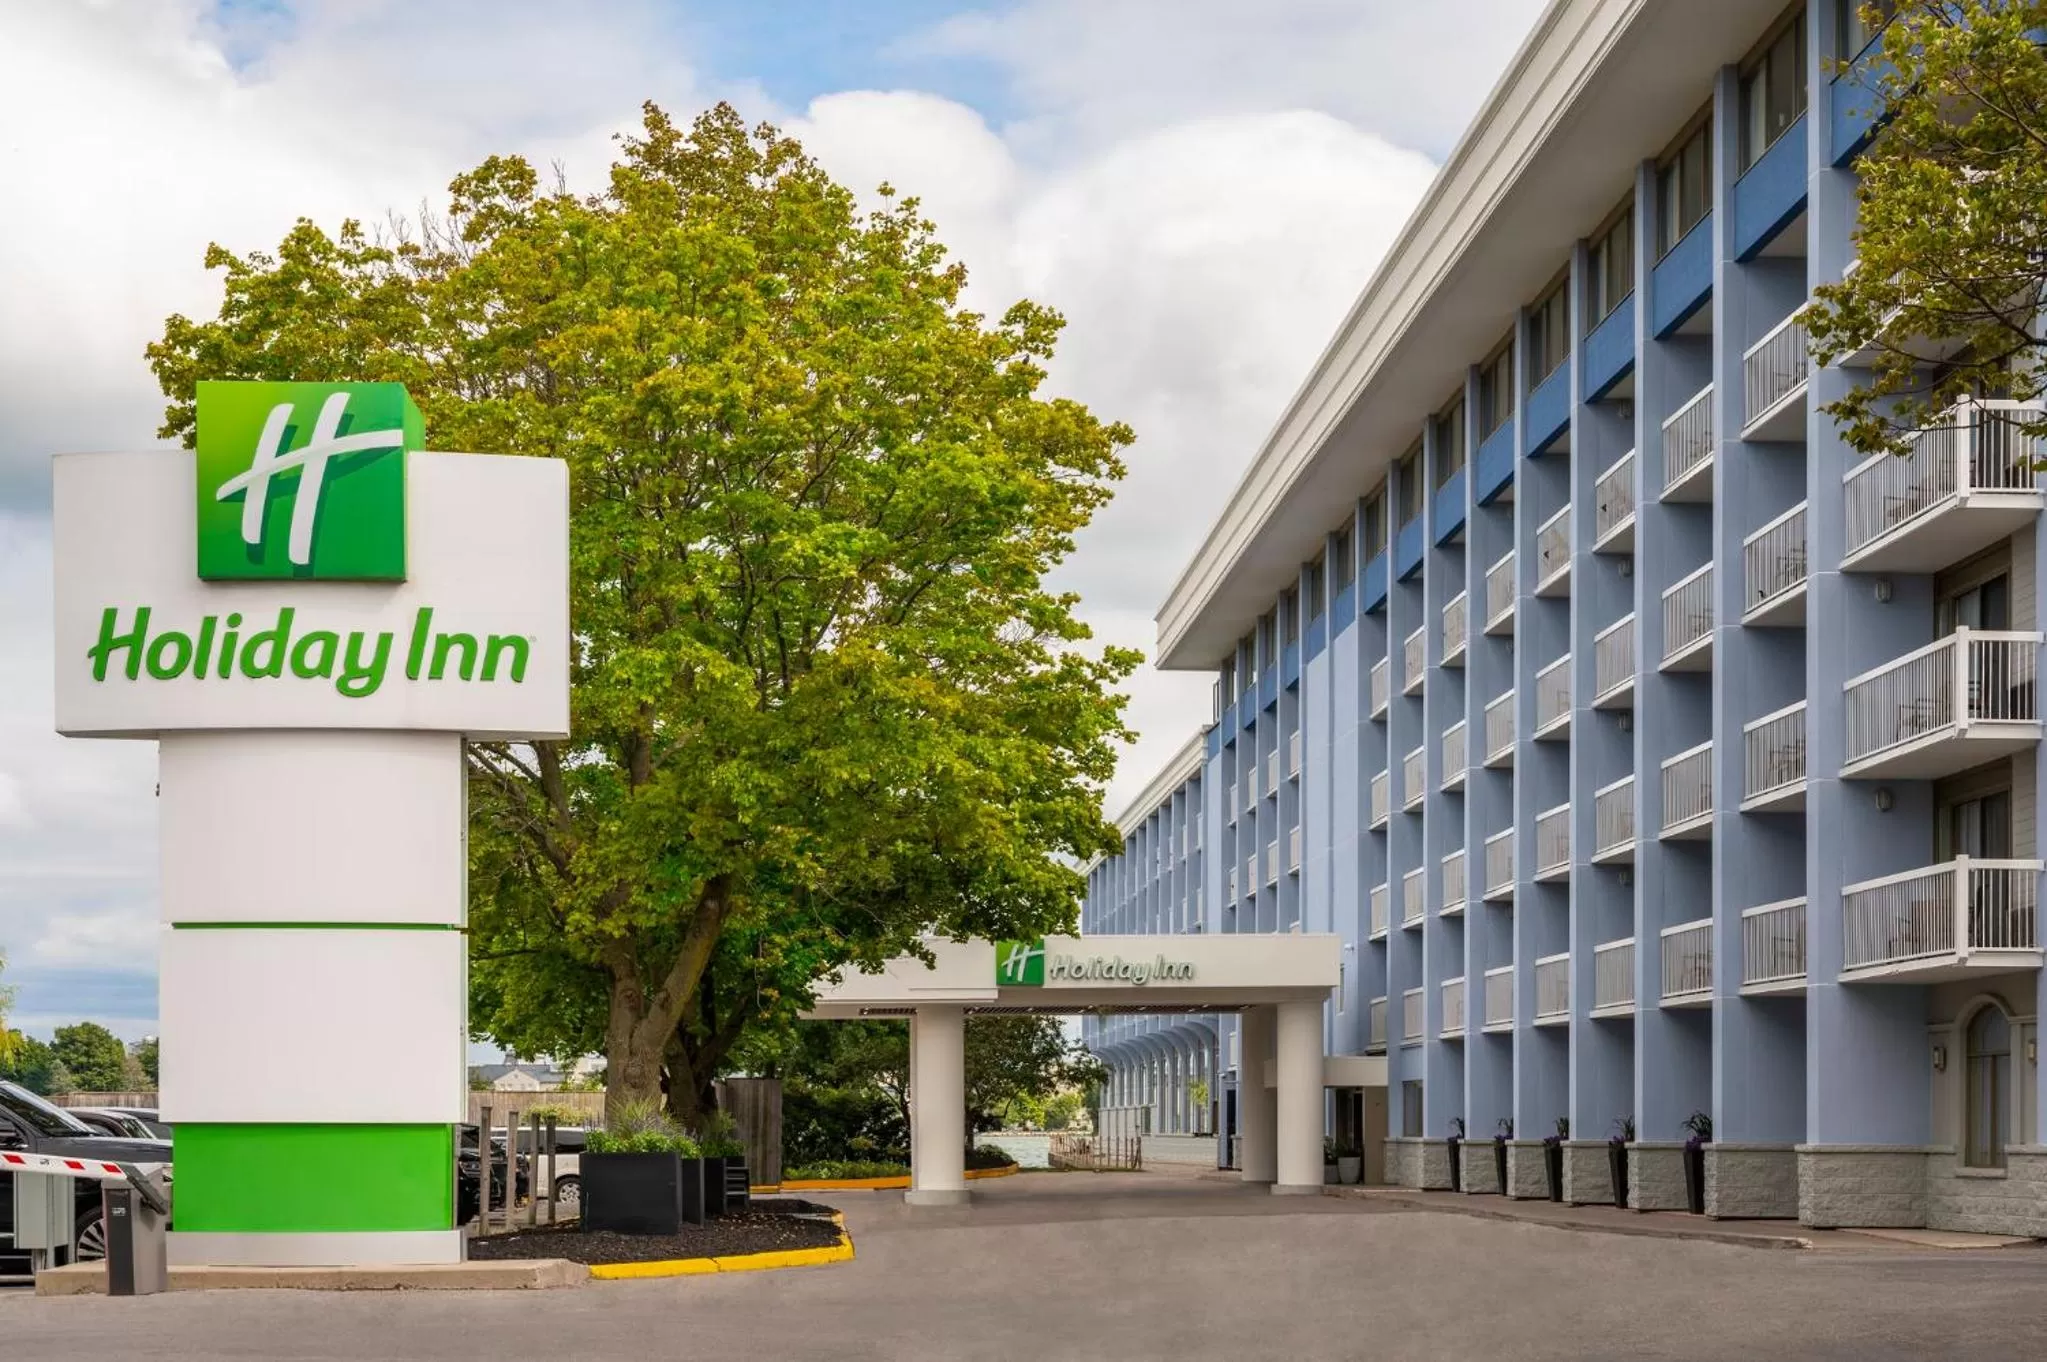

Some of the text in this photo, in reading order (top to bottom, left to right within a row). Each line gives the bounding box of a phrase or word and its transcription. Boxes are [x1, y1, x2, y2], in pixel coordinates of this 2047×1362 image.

[87, 607, 530, 698] Holiday Inn
[1050, 954, 1151, 985] Holiday
[1152, 953, 1193, 980] Inn
